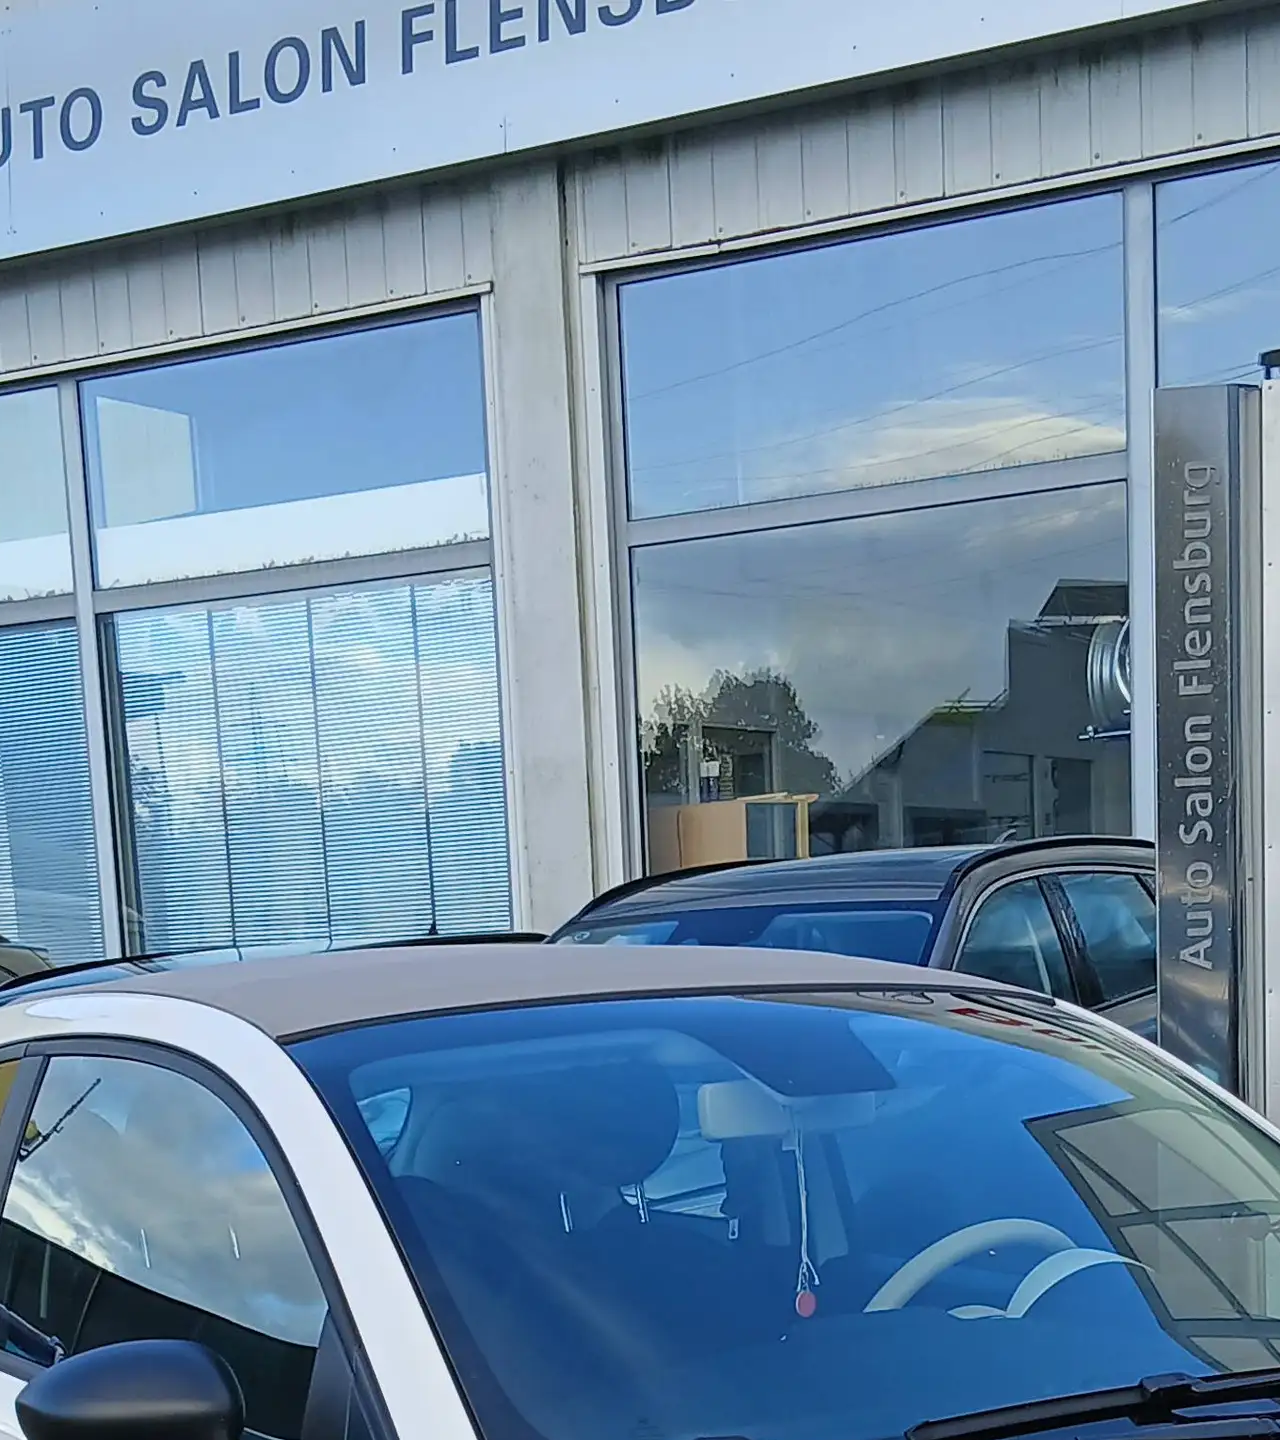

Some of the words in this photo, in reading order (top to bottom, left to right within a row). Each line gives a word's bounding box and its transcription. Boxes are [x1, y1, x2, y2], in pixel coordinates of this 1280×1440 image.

[131, 19, 367, 136] SALON
[1173, 460, 1219, 697] Flensburg
[1175, 713, 1214, 845] Salon
[1179, 862, 1216, 971] Auto
